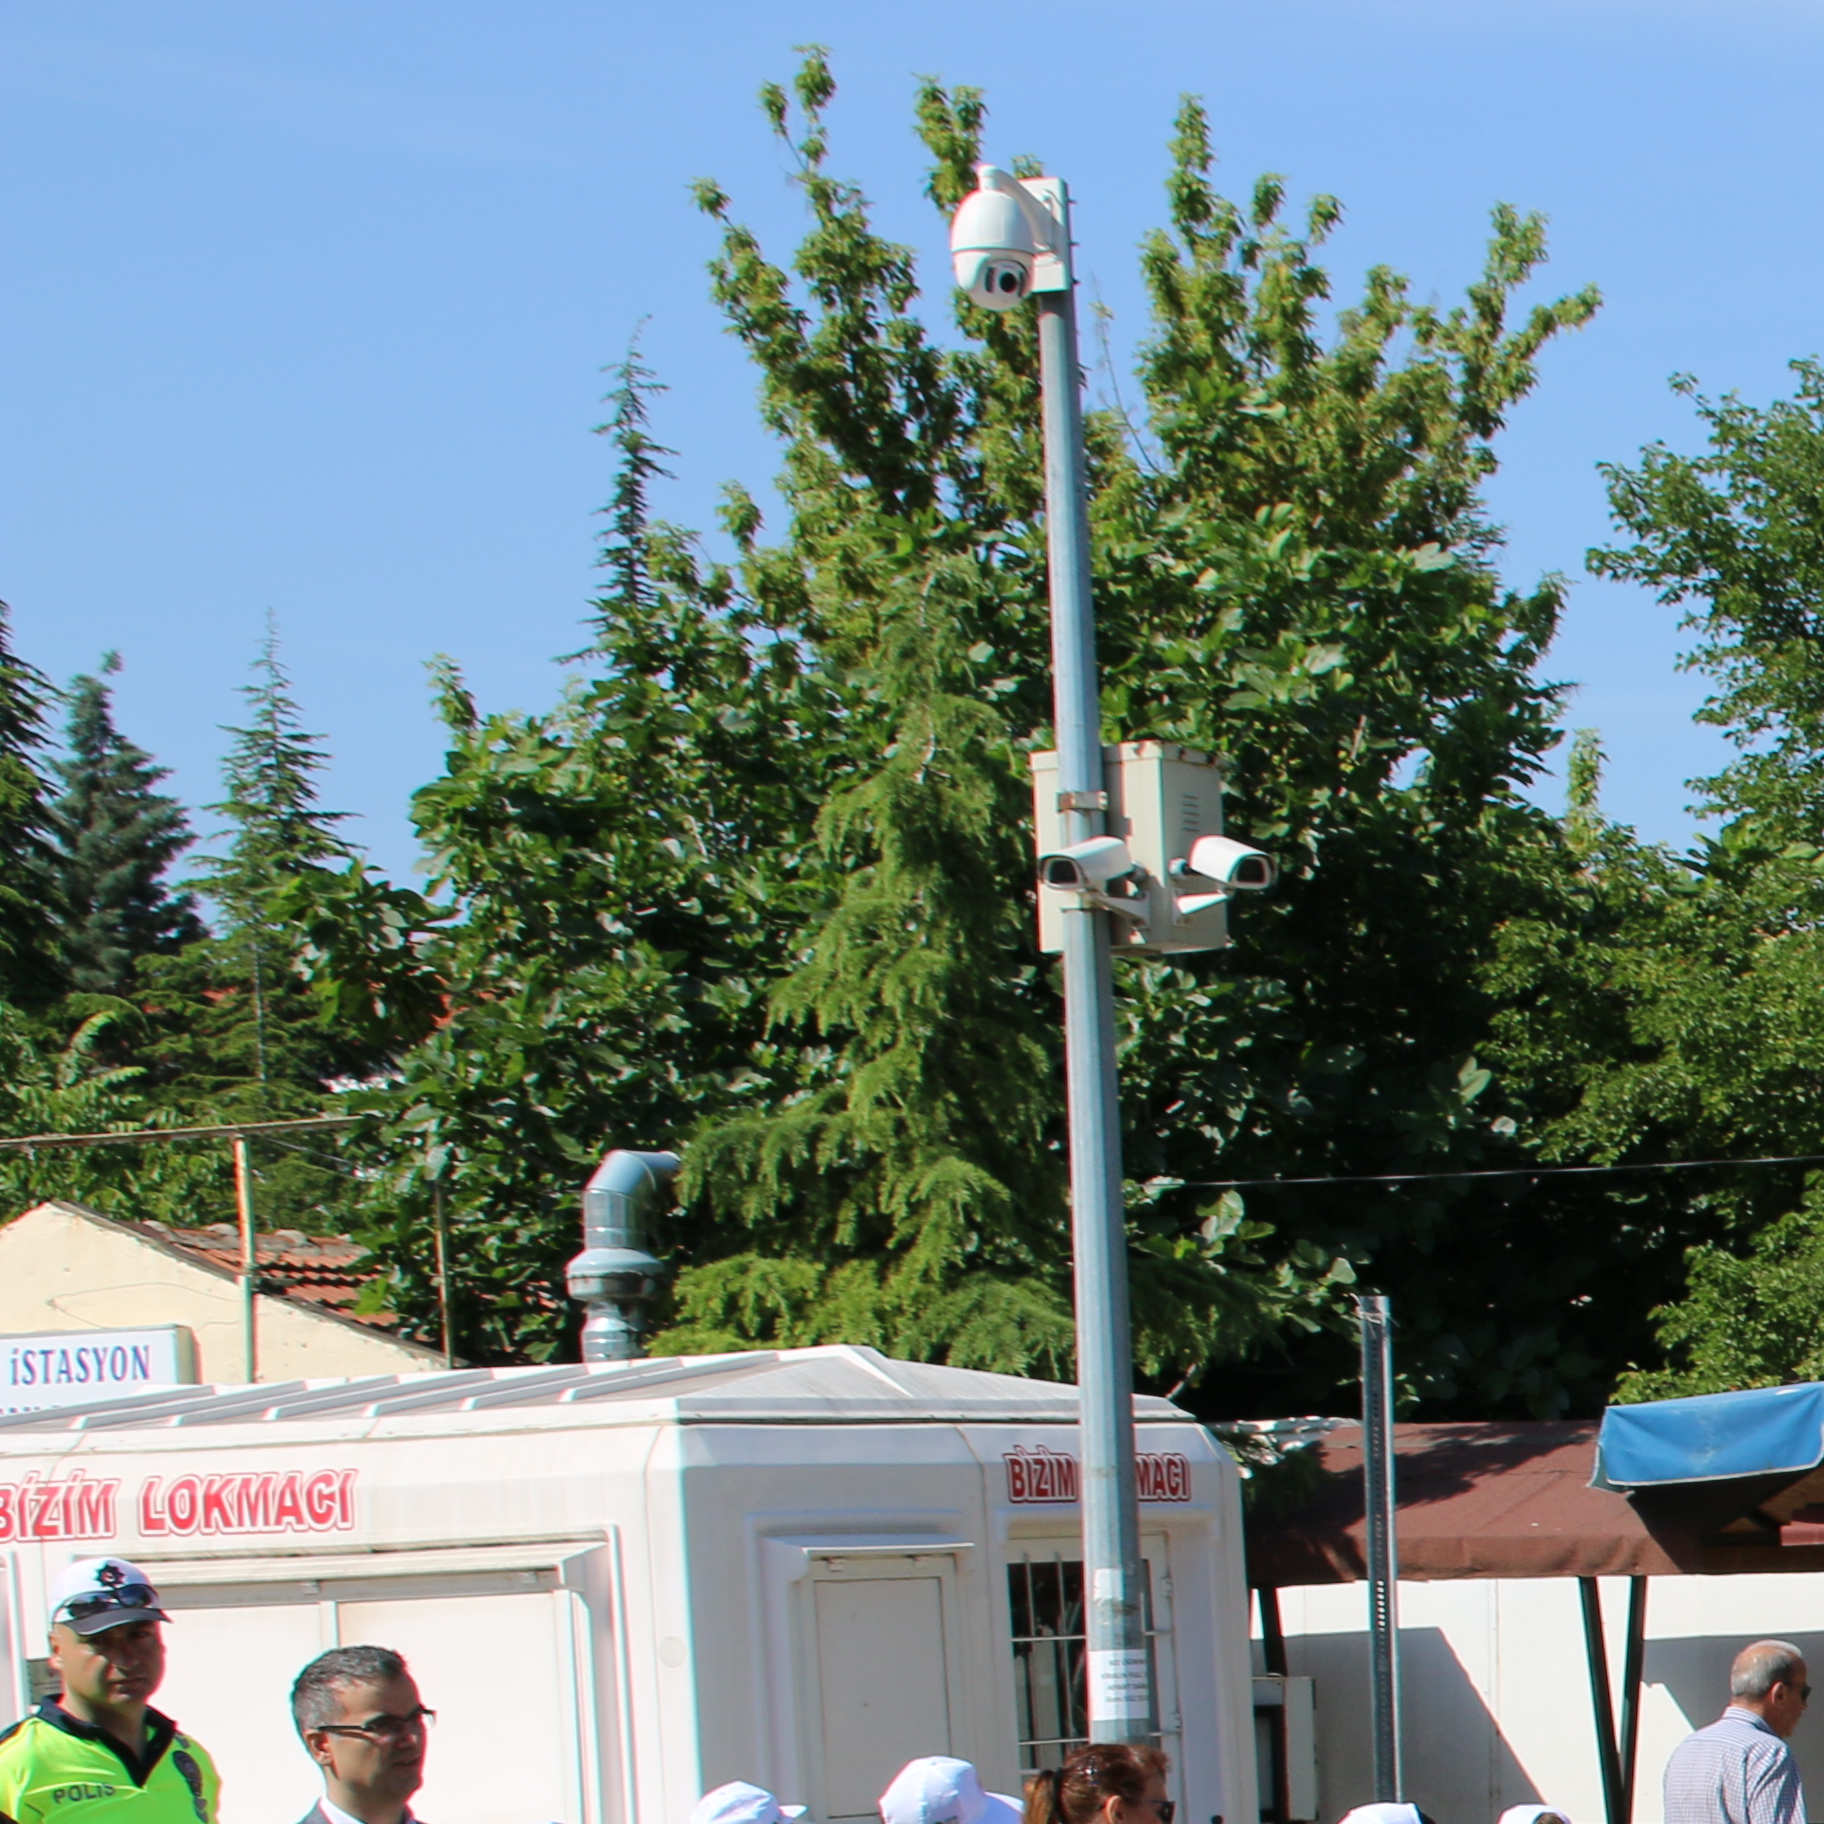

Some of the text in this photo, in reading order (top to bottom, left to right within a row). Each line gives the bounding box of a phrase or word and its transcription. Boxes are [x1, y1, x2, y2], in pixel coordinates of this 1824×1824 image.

[0, 1468, 359, 1544] BİZİM LOKMACI
[1002, 1444, 1192, 1503] BİZİM MACI
